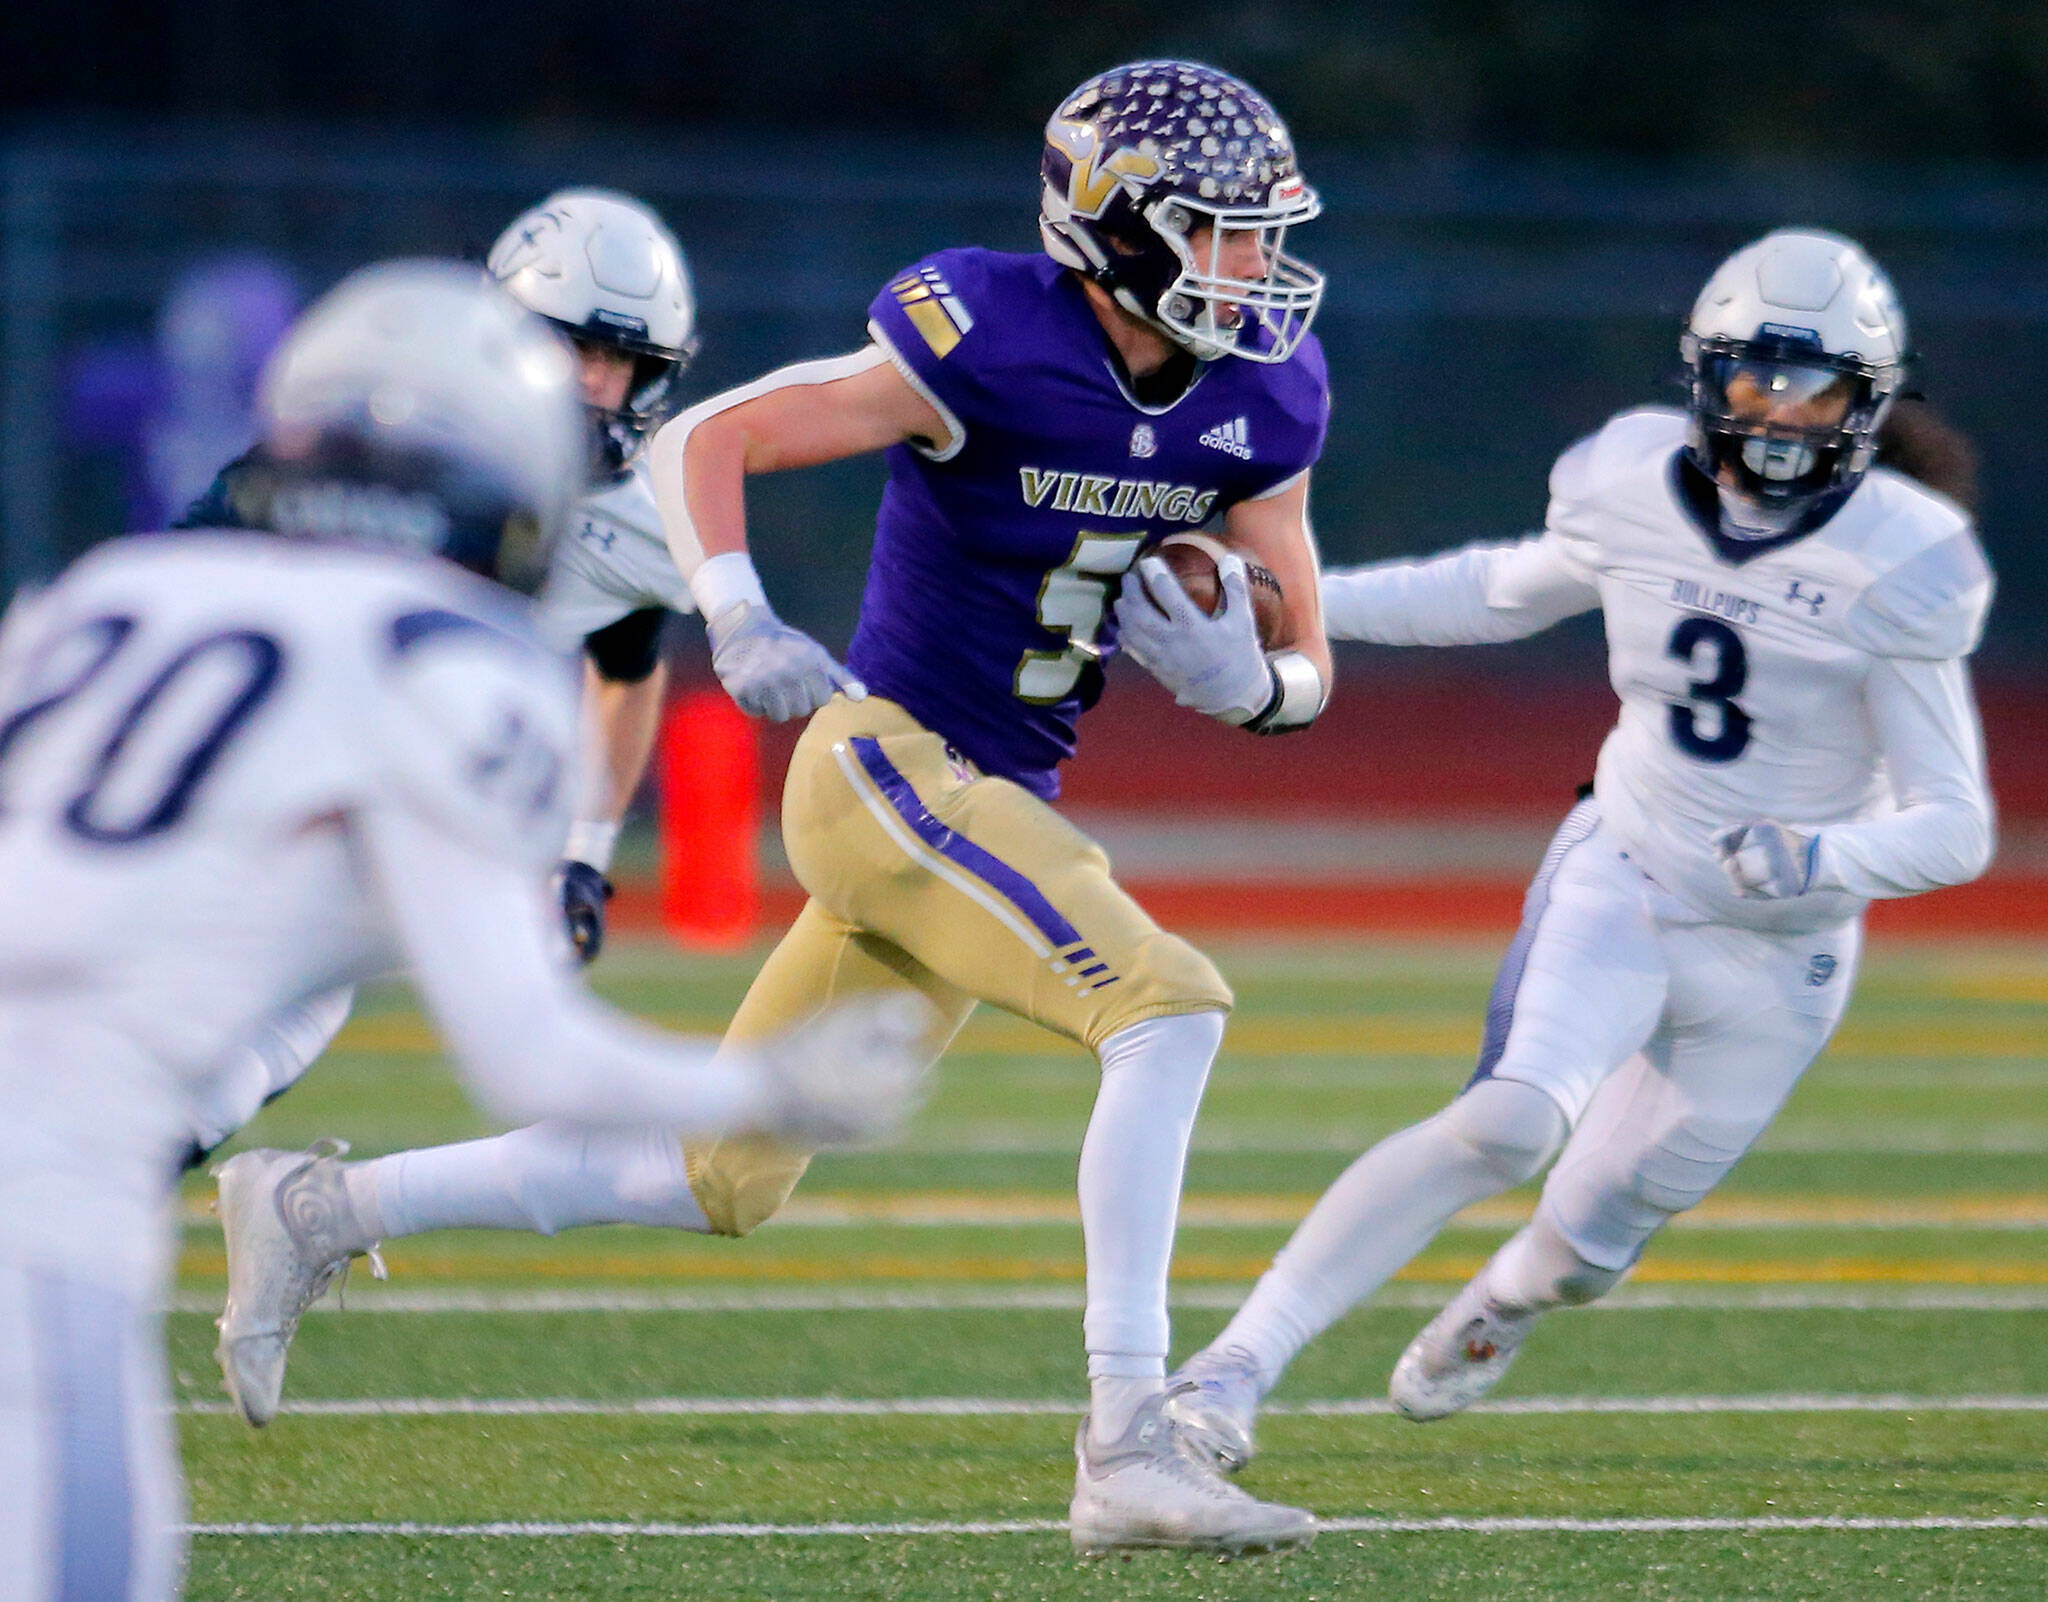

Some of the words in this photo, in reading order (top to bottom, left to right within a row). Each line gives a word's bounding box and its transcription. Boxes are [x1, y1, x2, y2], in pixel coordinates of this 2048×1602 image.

[1018, 467, 1219, 524] VIKINGS
[1198, 433, 1254, 461] adidas
[1012, 530, 1147, 706] 5
[1668, 615, 1755, 765] 3
